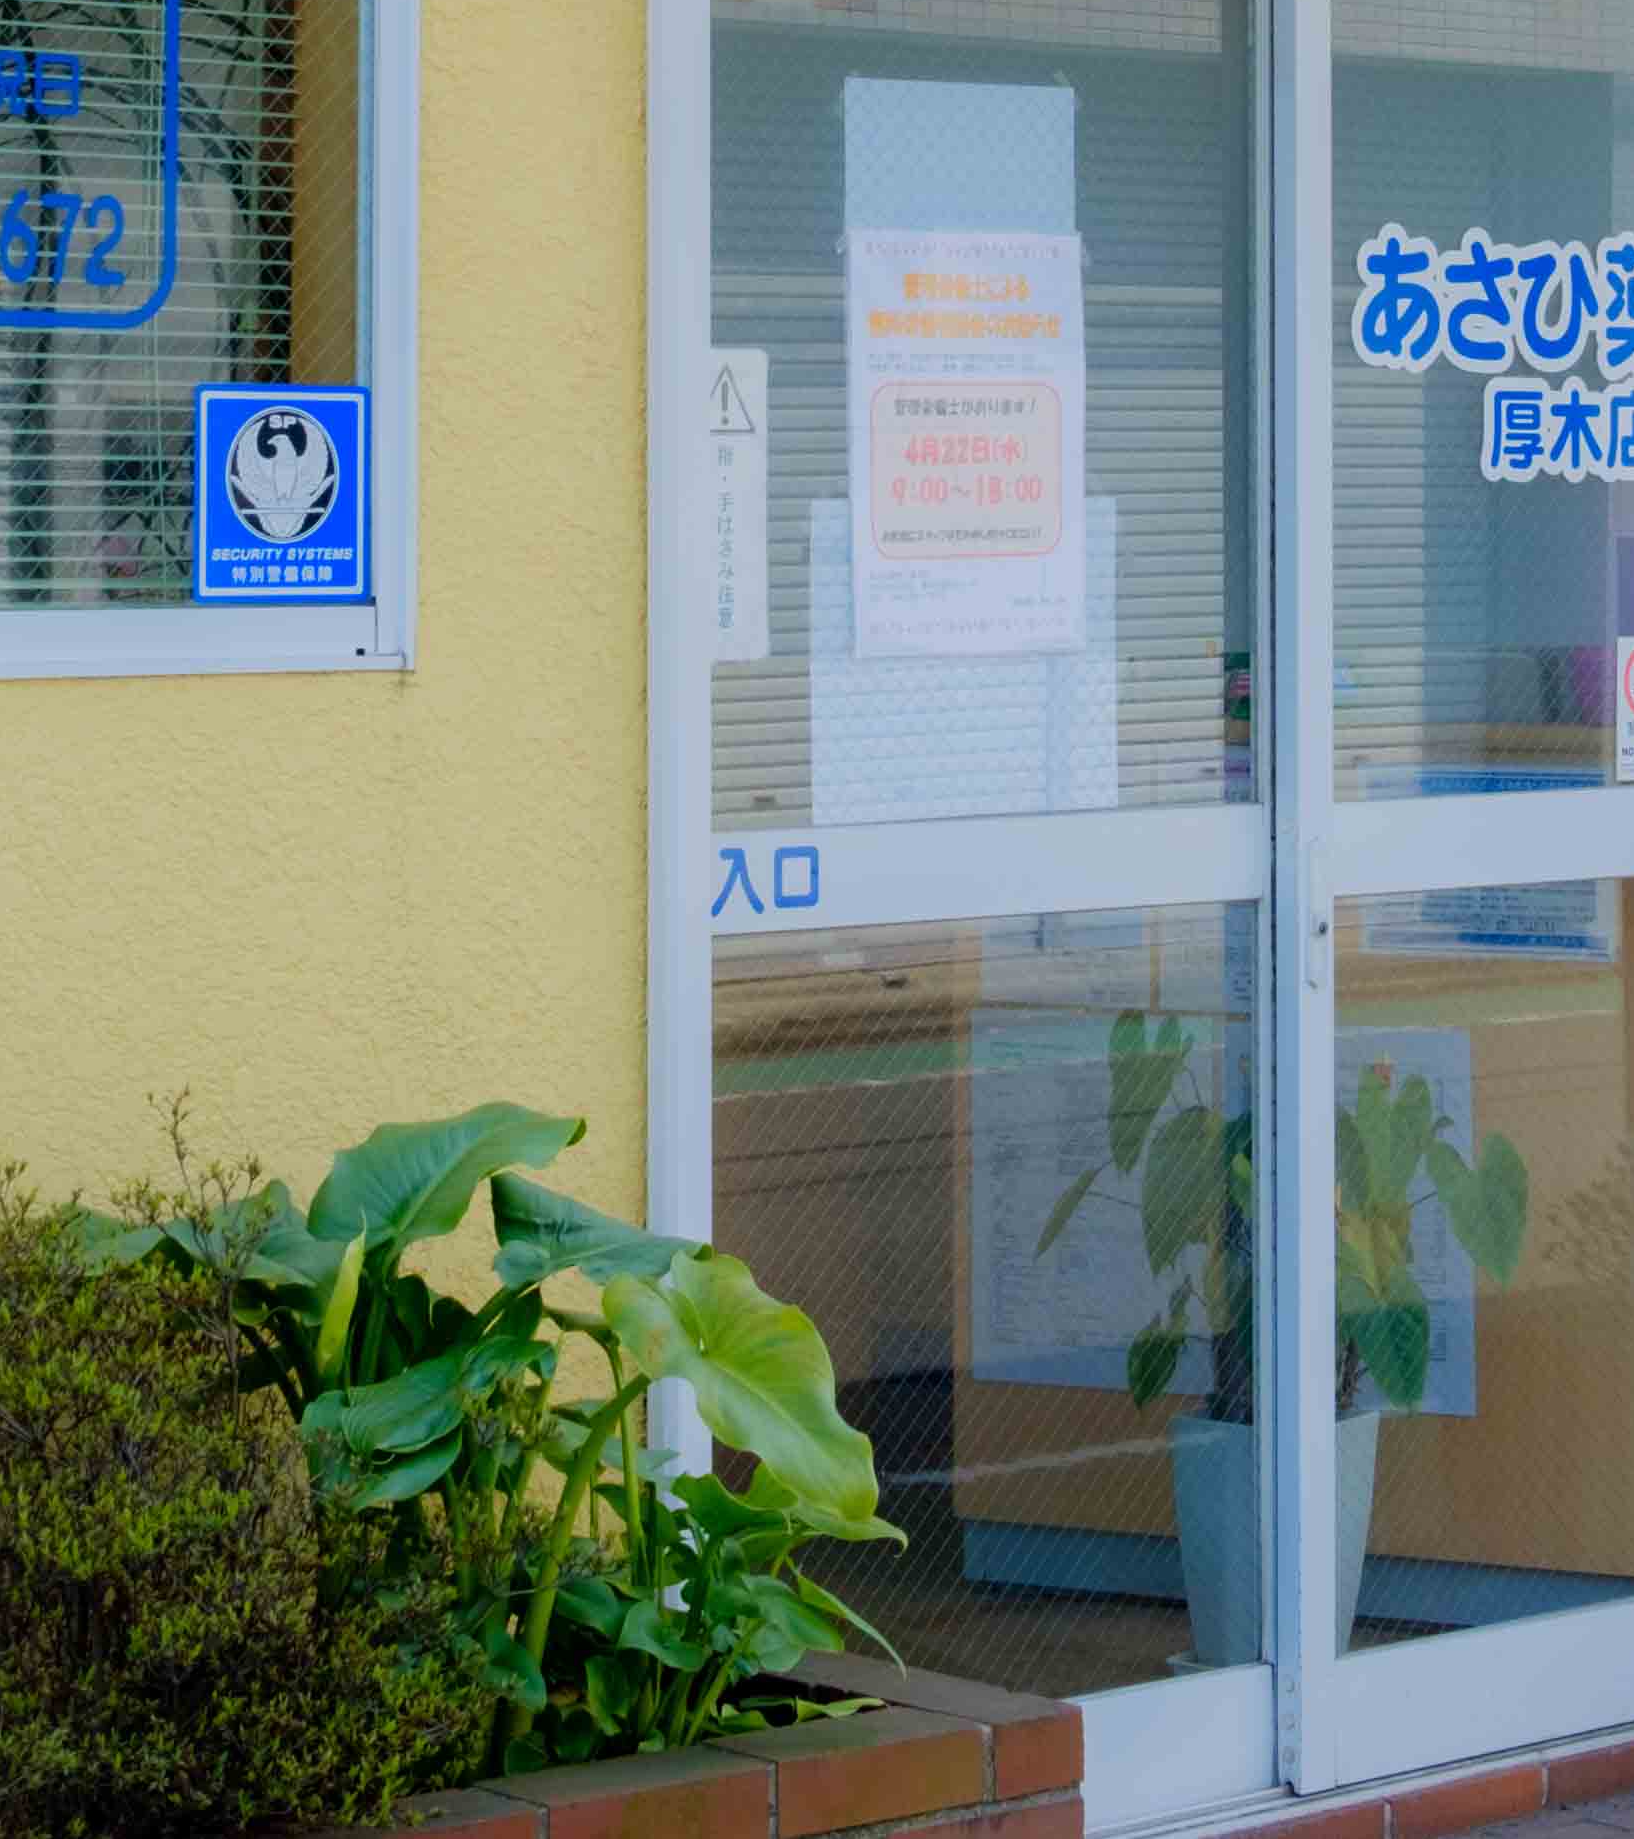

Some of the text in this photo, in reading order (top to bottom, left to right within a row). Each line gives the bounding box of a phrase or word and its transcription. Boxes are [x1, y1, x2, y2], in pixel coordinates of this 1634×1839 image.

[211, 547, 354, 562] SECURITY SYSTEMS
[711, 846, 819, 917] 入口
